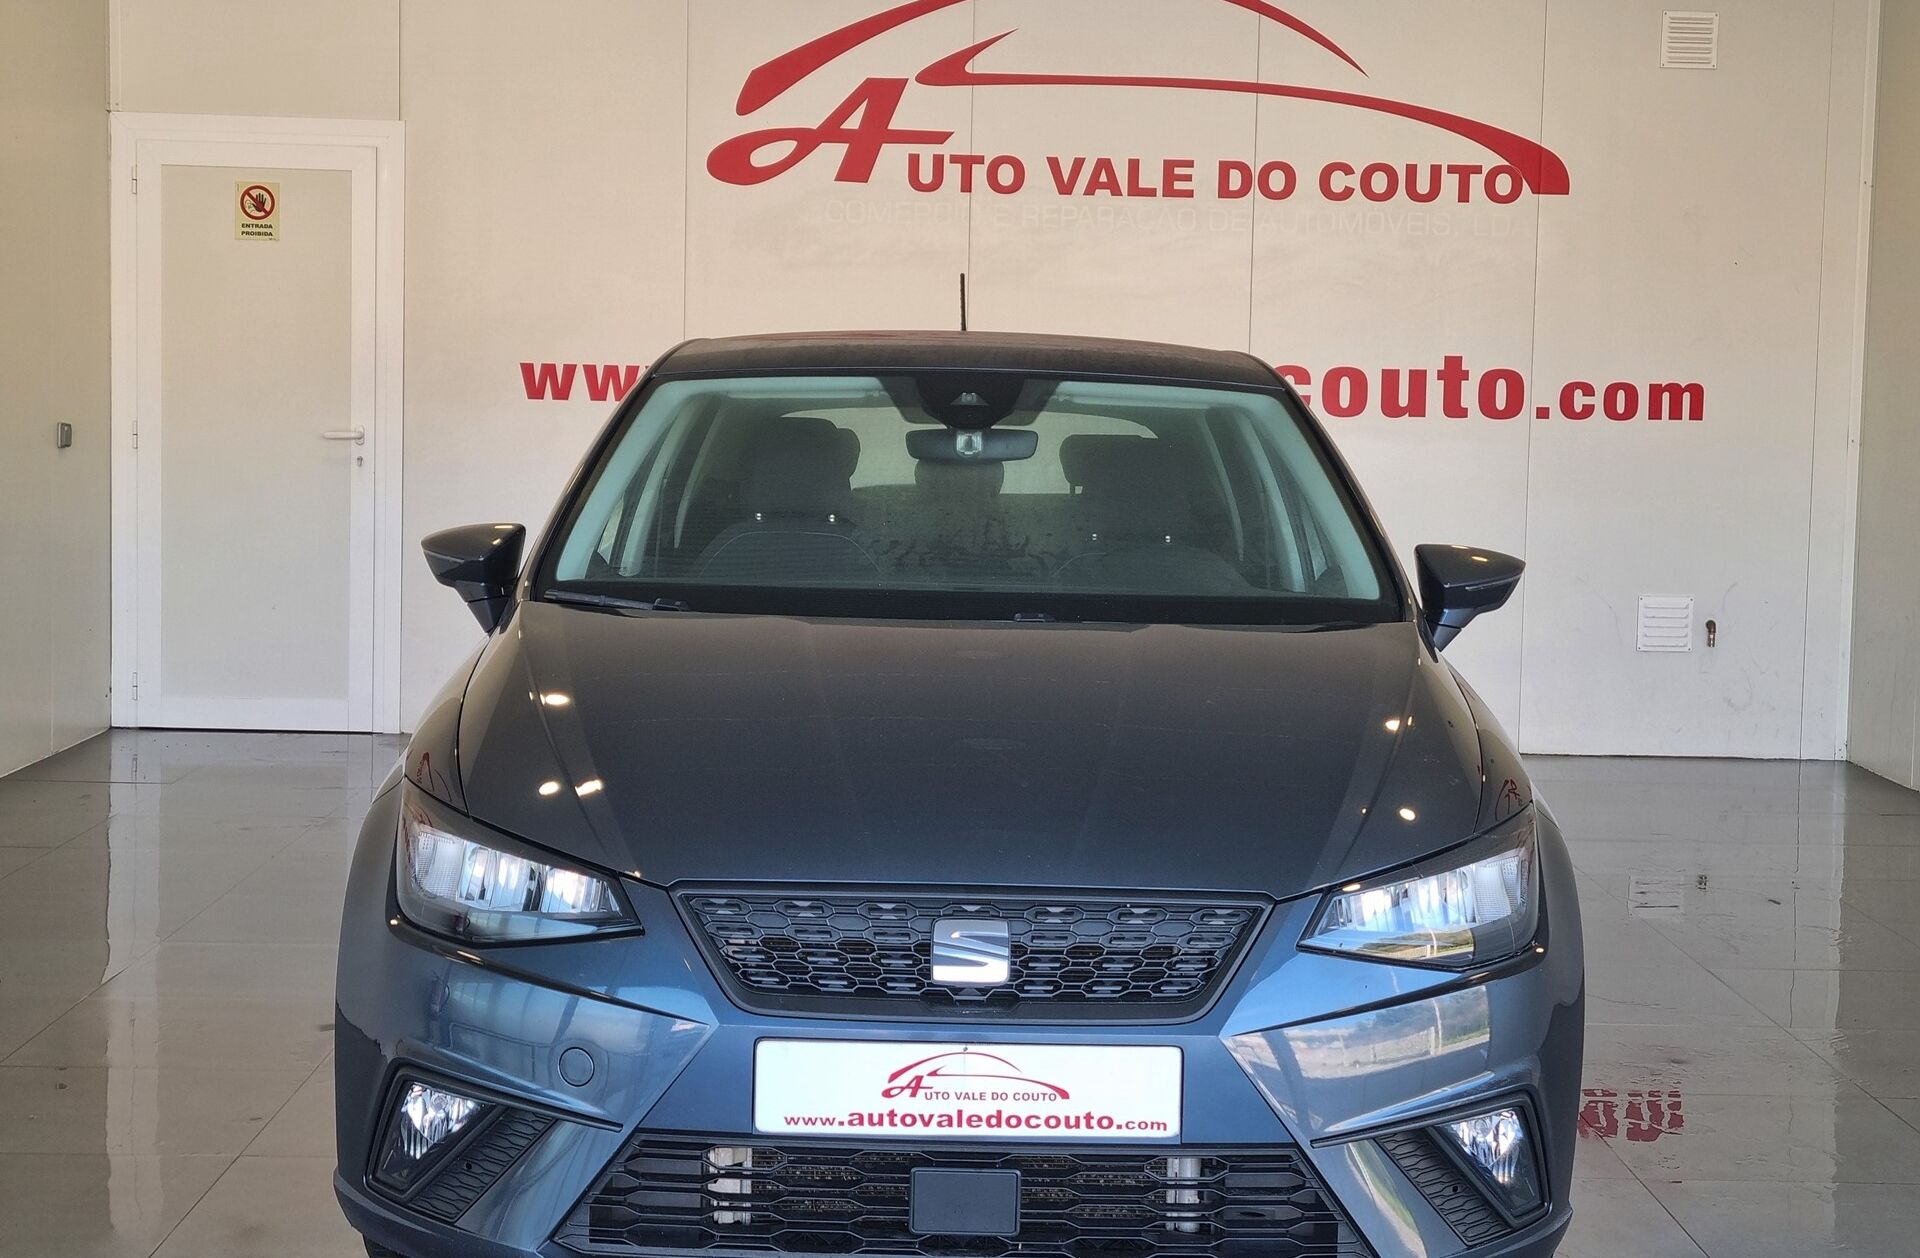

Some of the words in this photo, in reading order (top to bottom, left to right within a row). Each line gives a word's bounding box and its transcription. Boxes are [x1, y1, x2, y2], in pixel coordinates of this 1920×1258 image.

[1046, 156, 1197, 200] VALE
[1217, 159, 1298, 201] DO
[1319, 161, 1525, 205] COUTO
[1209, 206, 1251, 232] DE
[519, 361, 650, 402] ww
[954, 1091, 987, 1101] VALE
[991, 1091, 1009, 1101] DO
[1012, 1092, 1057, 1102] COUTO
[784, 1108, 1168, 1132] www.autovaledocouto.com
